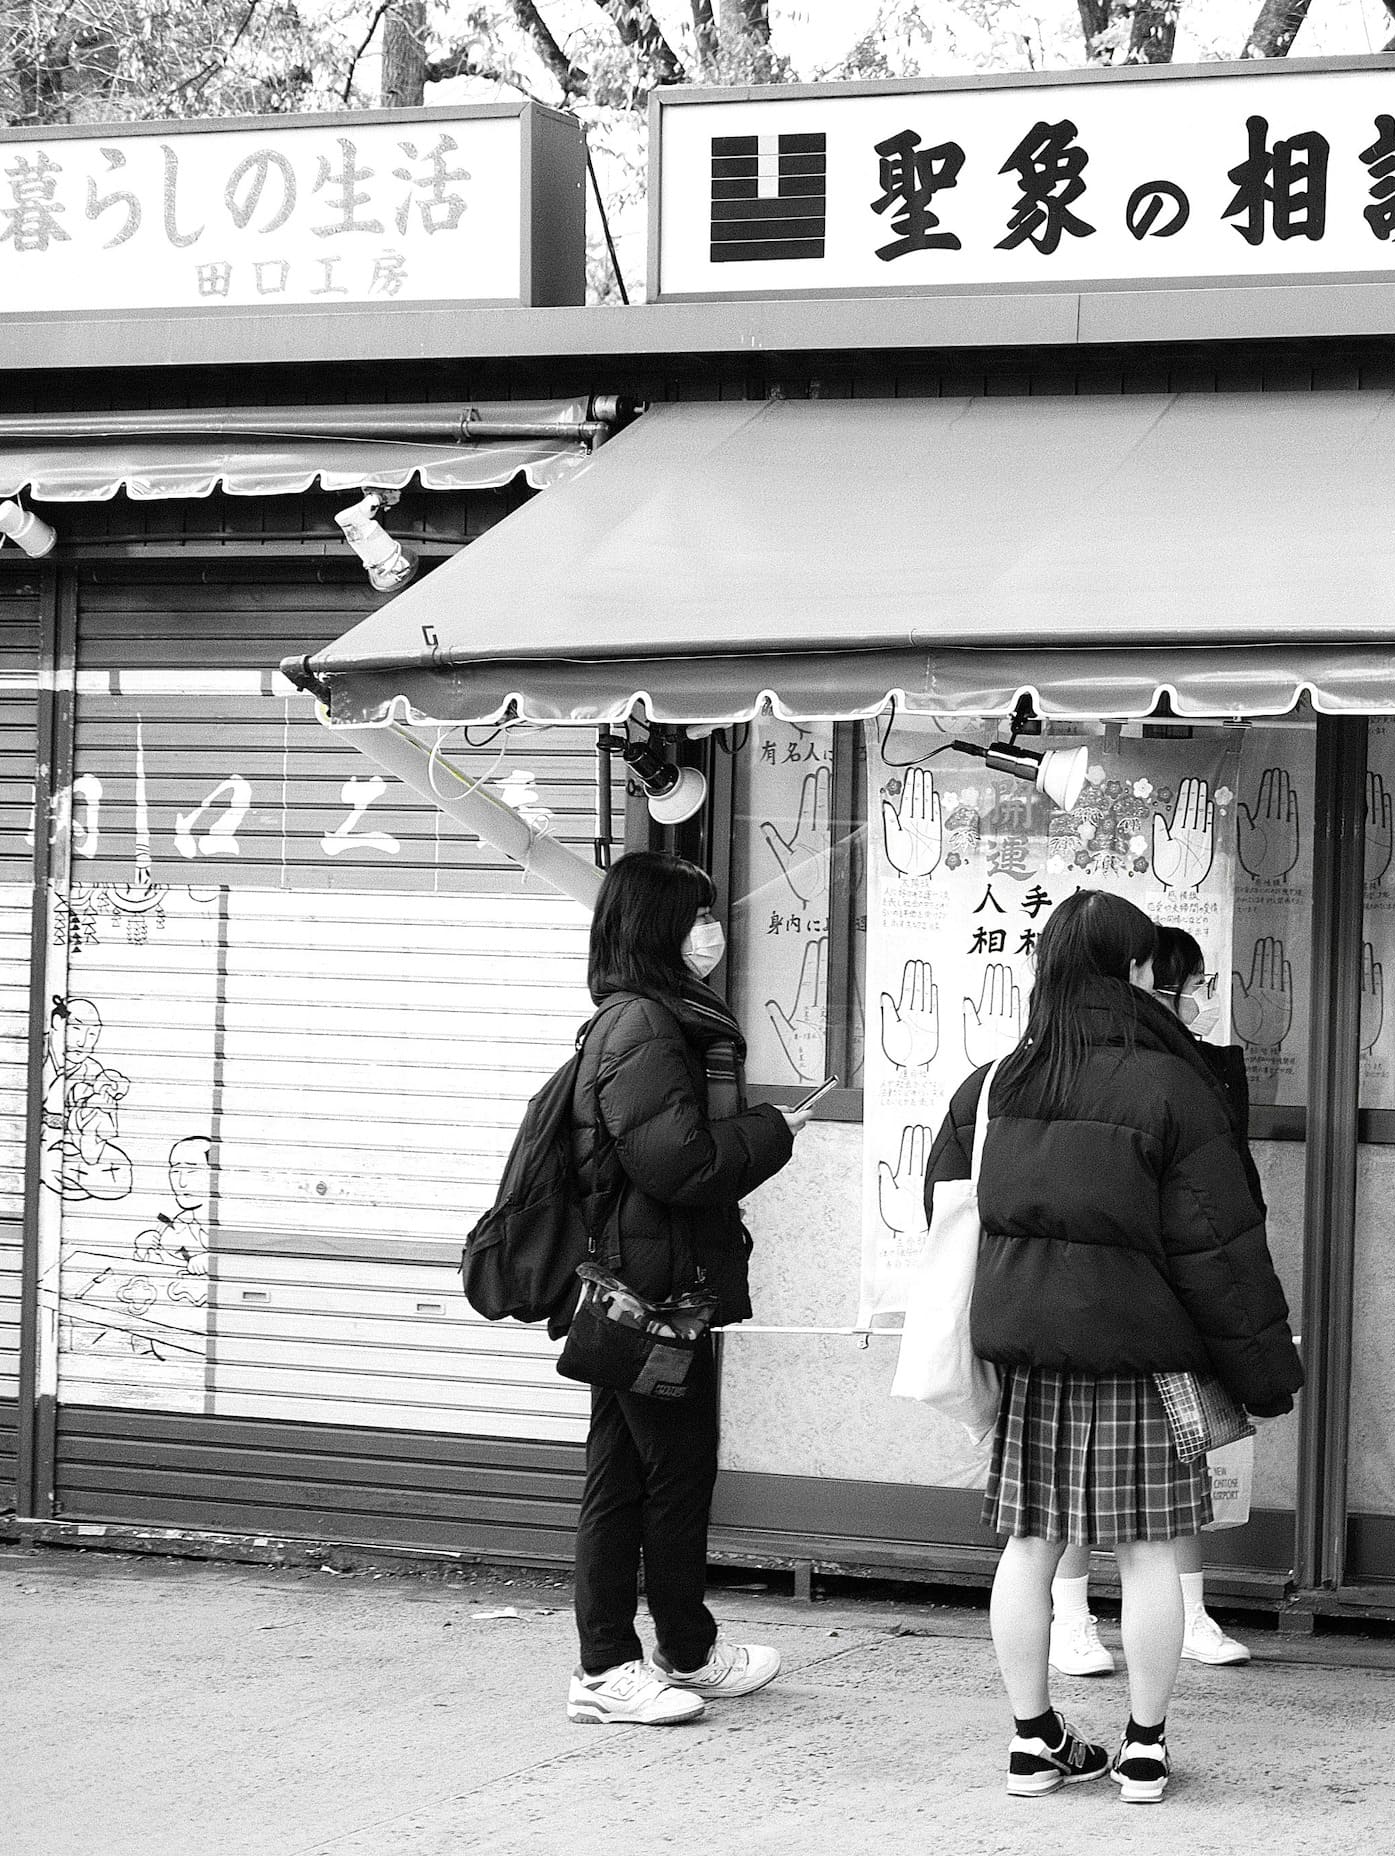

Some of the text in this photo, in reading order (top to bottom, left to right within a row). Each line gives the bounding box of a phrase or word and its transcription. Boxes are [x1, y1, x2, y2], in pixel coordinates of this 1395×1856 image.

[0, 133, 472, 253] 暮らしの生活
[195, 251, 408, 299] 田口工房
